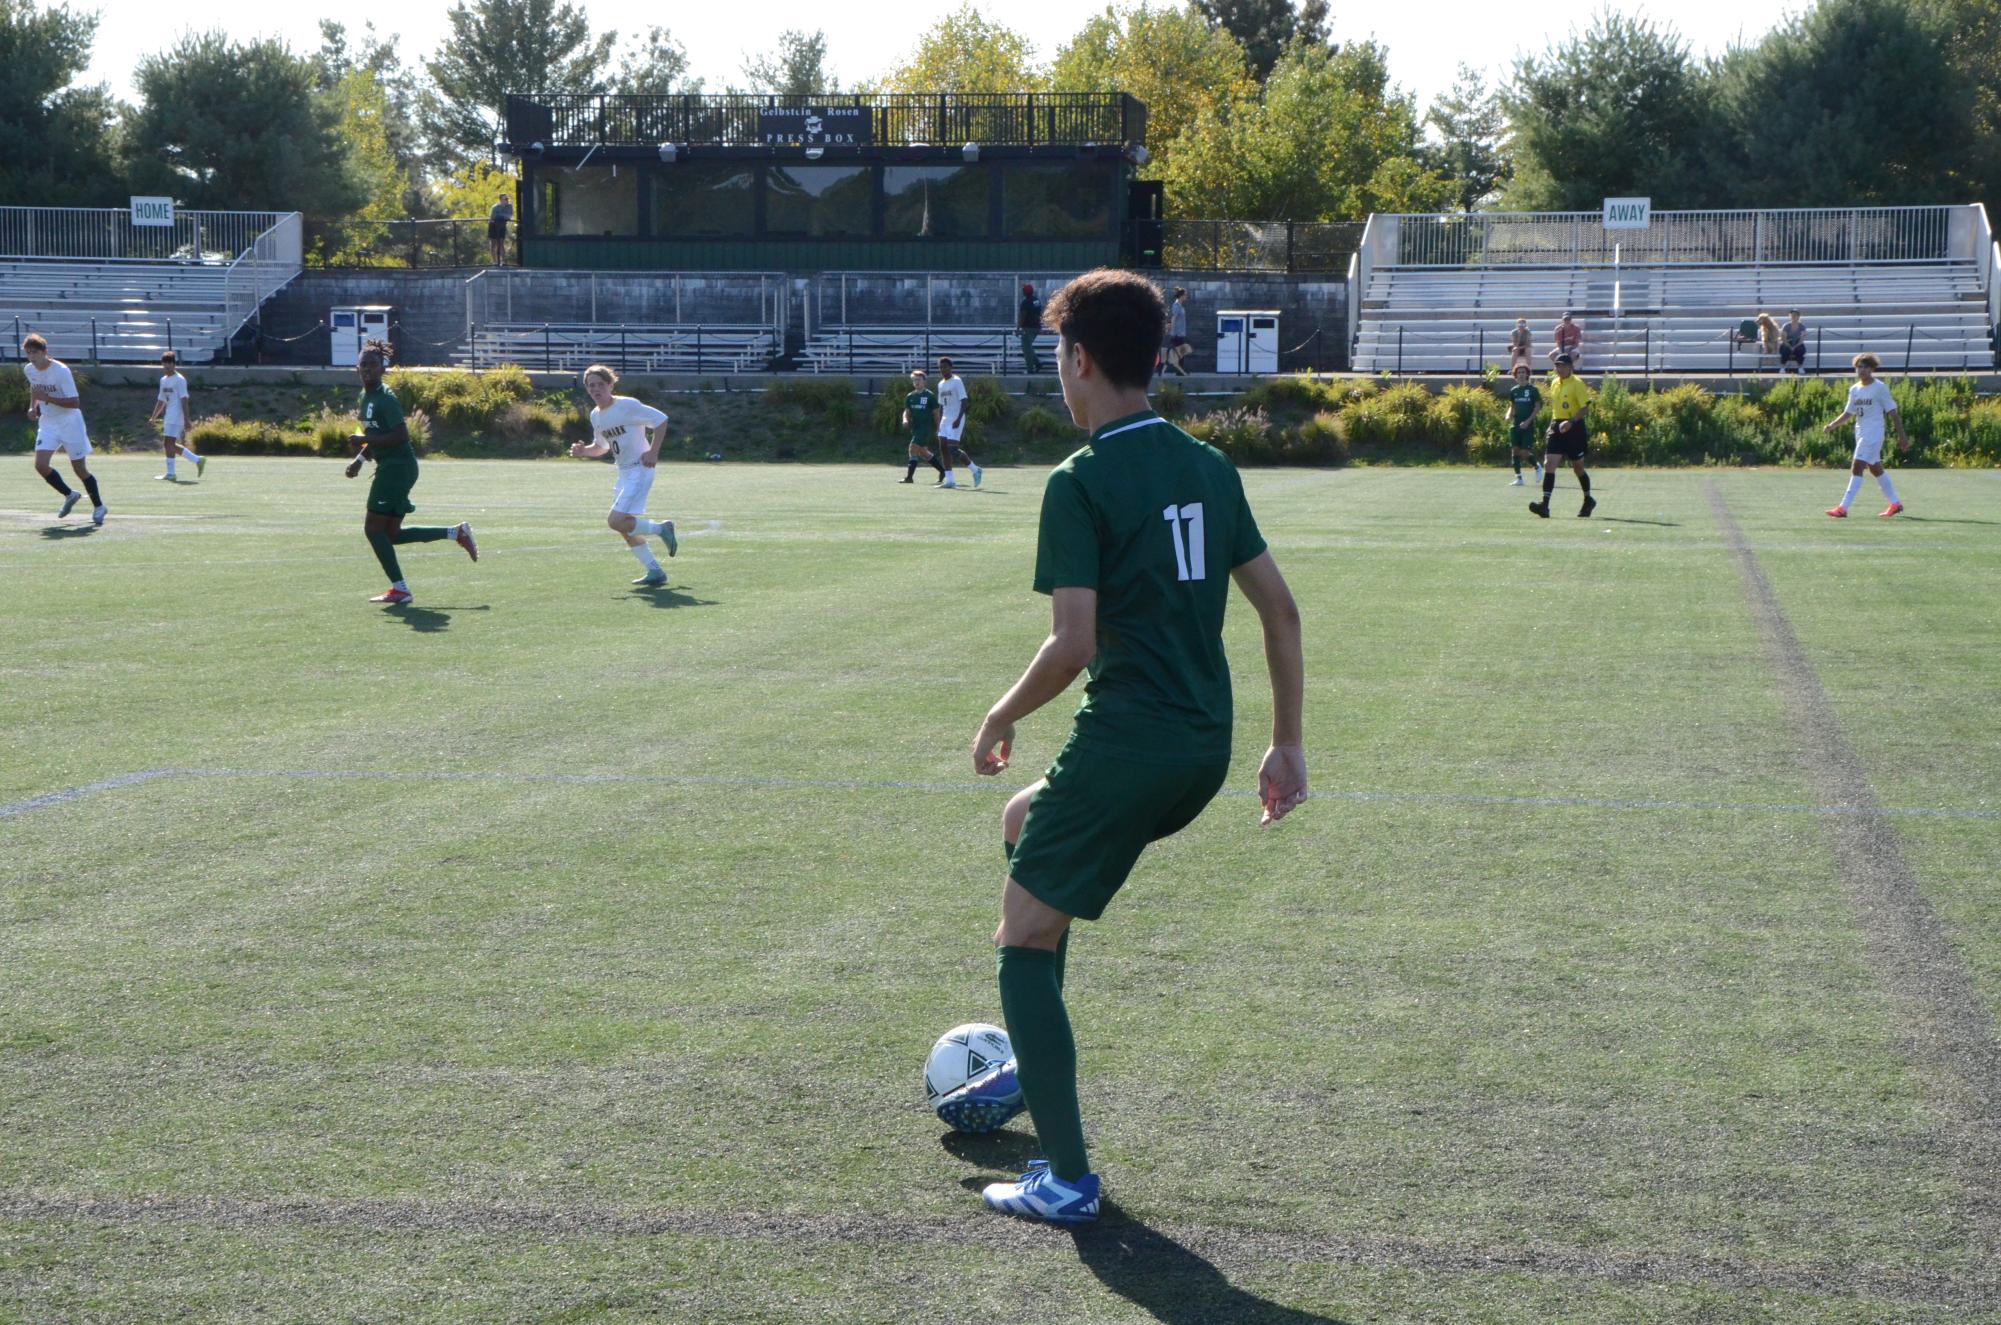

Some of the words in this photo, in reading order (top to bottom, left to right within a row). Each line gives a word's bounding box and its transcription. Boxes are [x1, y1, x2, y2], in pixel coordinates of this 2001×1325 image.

[827, 107, 860, 116] Rosen
[766, 133, 814, 143] PRESS
[825, 133, 855, 143] BOX
[135, 202, 170, 219] HOME
[1608, 204, 1646, 222] AWAY
[366, 402, 374, 419] 6
[1162, 502, 1206, 581] 11
